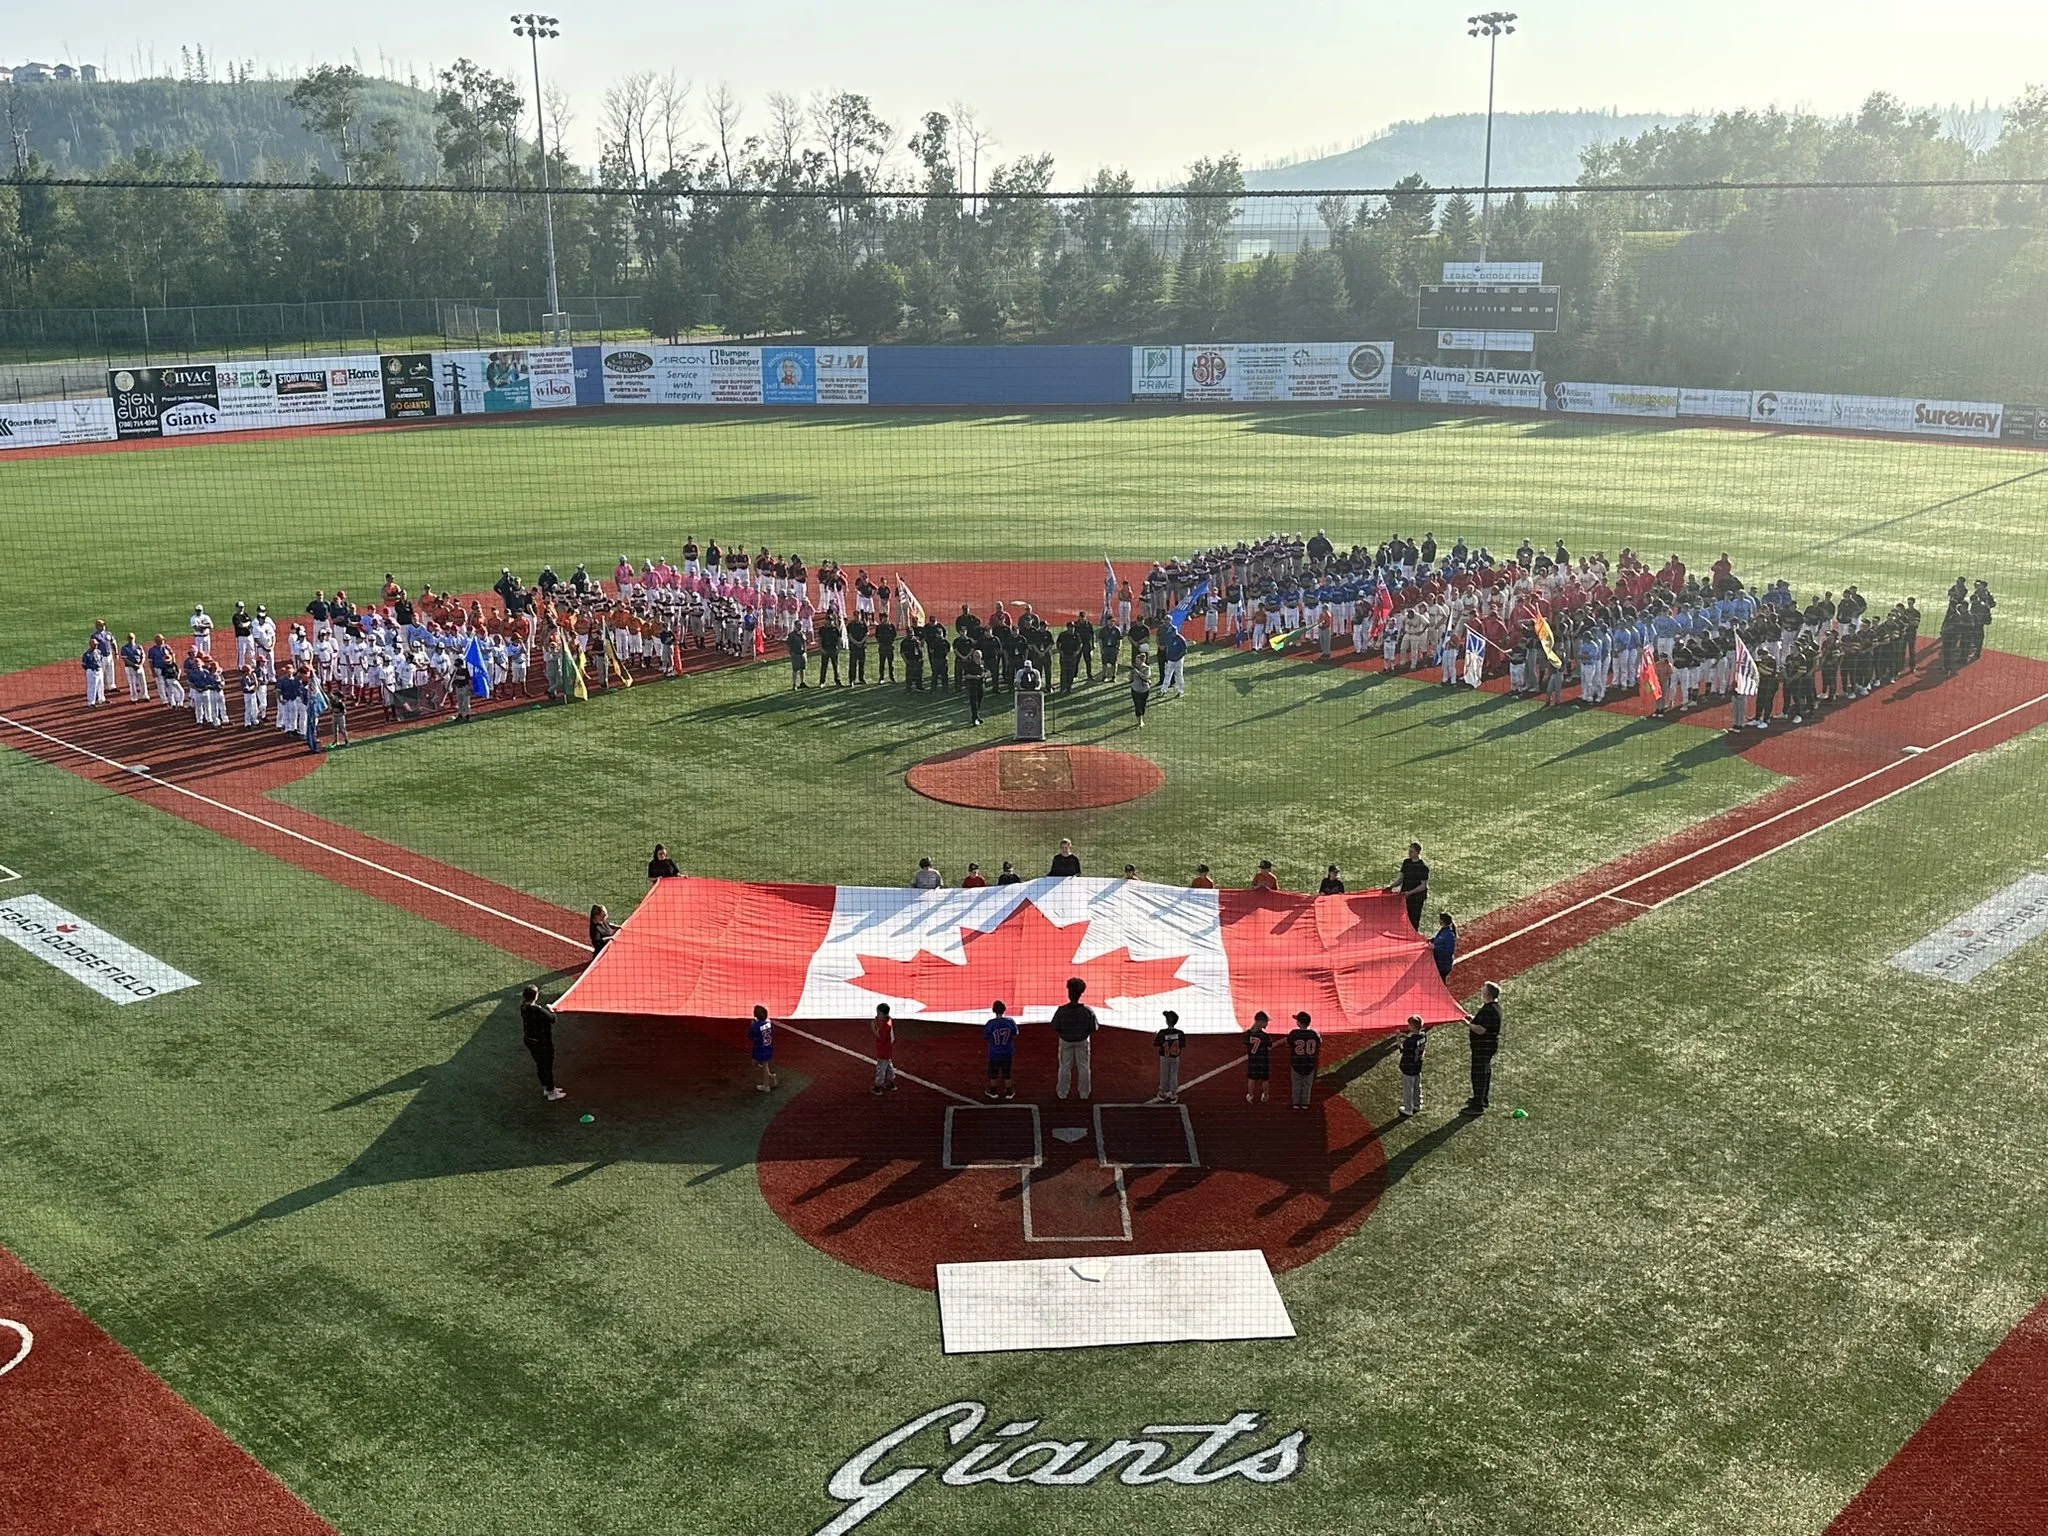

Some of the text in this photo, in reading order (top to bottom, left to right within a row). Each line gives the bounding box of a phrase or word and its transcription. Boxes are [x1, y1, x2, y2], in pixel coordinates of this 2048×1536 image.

[720, 350, 750, 358] Bumper
[606, 361, 650, 372] WORKWEAR
[730, 358, 760, 367] Bumper
[174, 371, 212, 384] HVAC
[278, 372, 324, 384] STONY VALLEY
[348, 369, 380, 379] Home
[667, 370, 698, 379] Service
[1422, 369, 1541, 384] Aluma SAFWAY
[536, 379, 571, 396] wilson
[664, 391, 702, 400] Integrity
[1780, 396, 1822, 406] CREATIVE
[404, 400, 430, 410] GIANTS!
[117, 405, 158, 420] GURU
[166, 412, 216, 427] Giants
[1914, 403, 2000, 432] Sureway
[8, 418, 32, 427] GOLDEN
[41, 934, 110, 969] DODGE
[98, 966, 157, 996] FIELD
[992, 1028, 1011, 1046] 17
[1162, 1040, 1180, 1056] 14
[1250, 1038, 1261, 1054] 7
[1294, 1039, 1316, 1055] 20
[811, 1399, 1310, 1536] Giants
